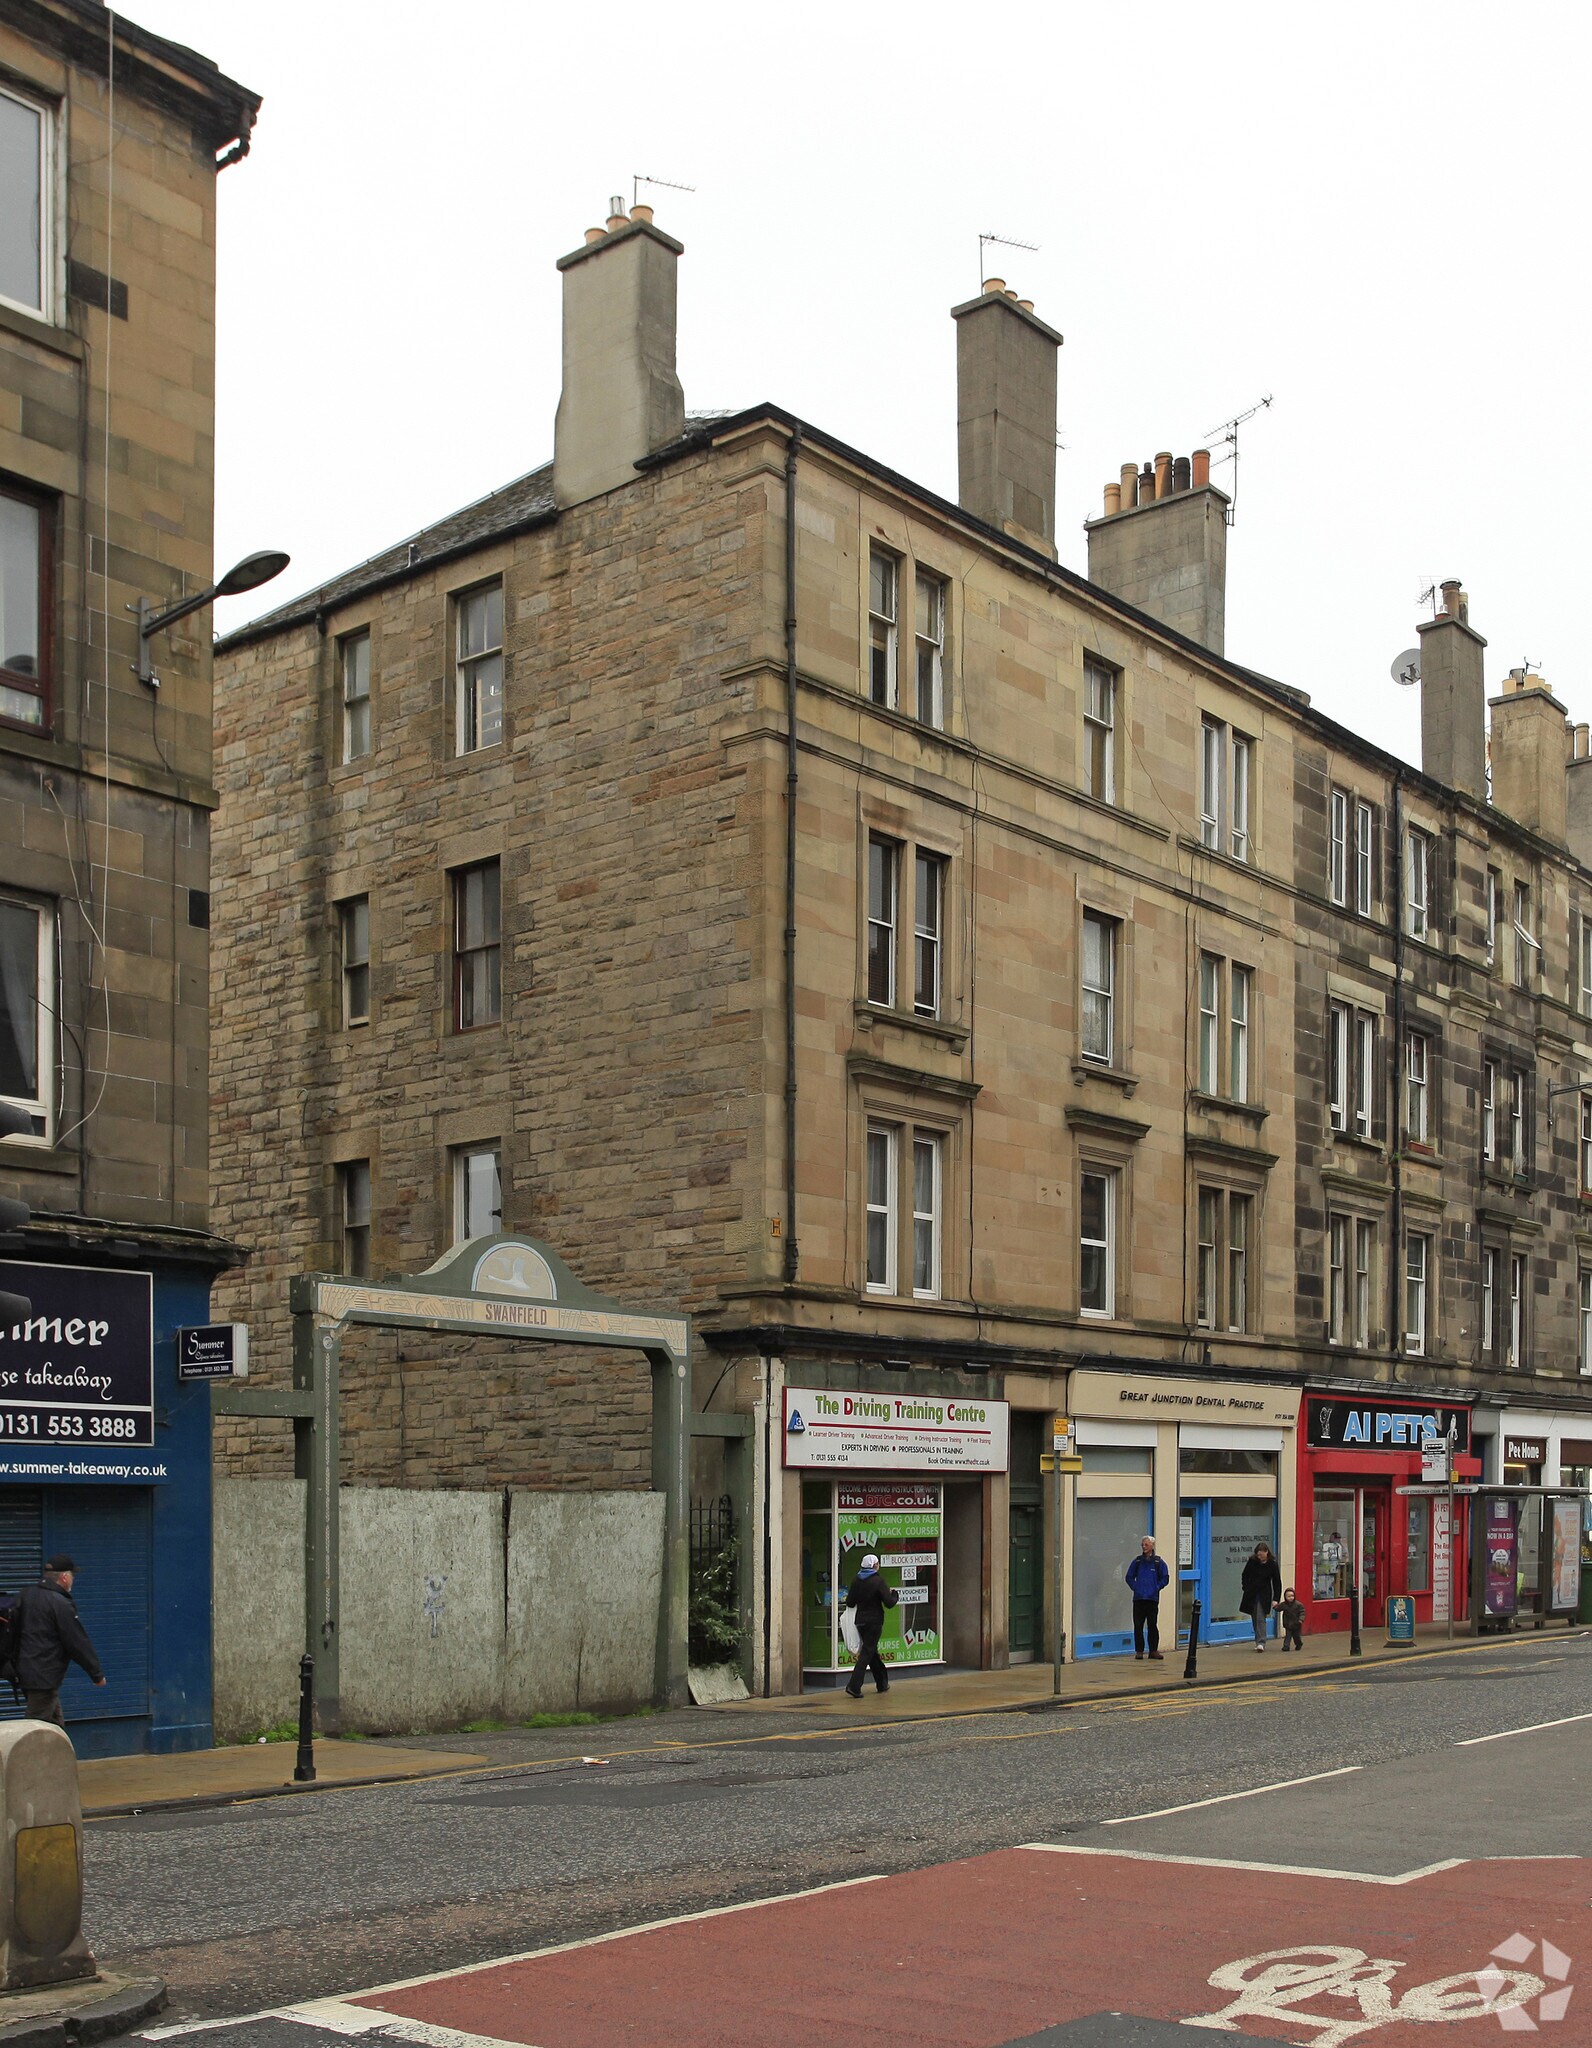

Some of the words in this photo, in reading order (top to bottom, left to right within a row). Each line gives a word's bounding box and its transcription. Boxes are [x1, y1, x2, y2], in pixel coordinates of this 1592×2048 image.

[485, 1303, 547, 1325] SWANFIELD
[188, 1332, 225, 1356] Summer
[0, 1370, 18, 1387] se
[25, 1362, 112, 1401] takeaway
[1120, 1390, 1149, 1402] GREAT
[1152, 1392, 1193, 1405] JUNCTION
[1196, 1395, 1226, 1408] DENTAL
[1228, 1398, 1265, 1410] PRACTICE
[815, 1395, 839, 1415] The
[843, 1397, 890, 1422] Driving
[895, 1400, 943, 1425] Training
[947, 1403, 986, 1423] Centre
[47, 1415, 84, 1436] 553
[89, 1416, 136, 1438] 3888
[1375, 1412, 1437, 1444] PETS
[840, 1432, 855, 1440] Training
[895, 1434, 909, 1442] Training
[918, 1435, 931, 1443] Driving
[841, 1443, 862, 1451] EXPERTS
[869, 1444, 890, 1453] DRIVING
[898, 1445, 935, 1454] PROFESSIONALS
[936, 1446, 942, 1454] IN
[942, 1447, 964, 1455] TRAINING
[1508, 1441, 1521, 1458] Pet
[1521, 1442, 1540, 1459] Home
[839, 1484, 861, 1493] BECOME
[867, 1485, 890, 1493] DRIVING
[891, 1485, 924, 1494] INSTRUCTOR
[925, 1485, 939, 1494] WITH
[838, 1515, 857, 1524] PASS
[859, 1515, 877, 1524] FAST
[879, 1515, 902, 1524] USING
[904, 1515, 920, 1524] OUR
[922, 1515, 938, 1524] FAST
[877, 1527, 902, 1536] TRACK
[905, 1526, 939, 1536] COURSES
[891, 1556, 909, 1564] BLOCK
[877, 1640, 900, 1650] OURSE
[838, 1655, 859, 1665] CLAS
[880, 1652, 895, 1661] ASS
[897, 1652, 905, 1660] IN
[906, 1651, 912, 1659] 3
[913, 1649, 938, 1659] WEEKS
